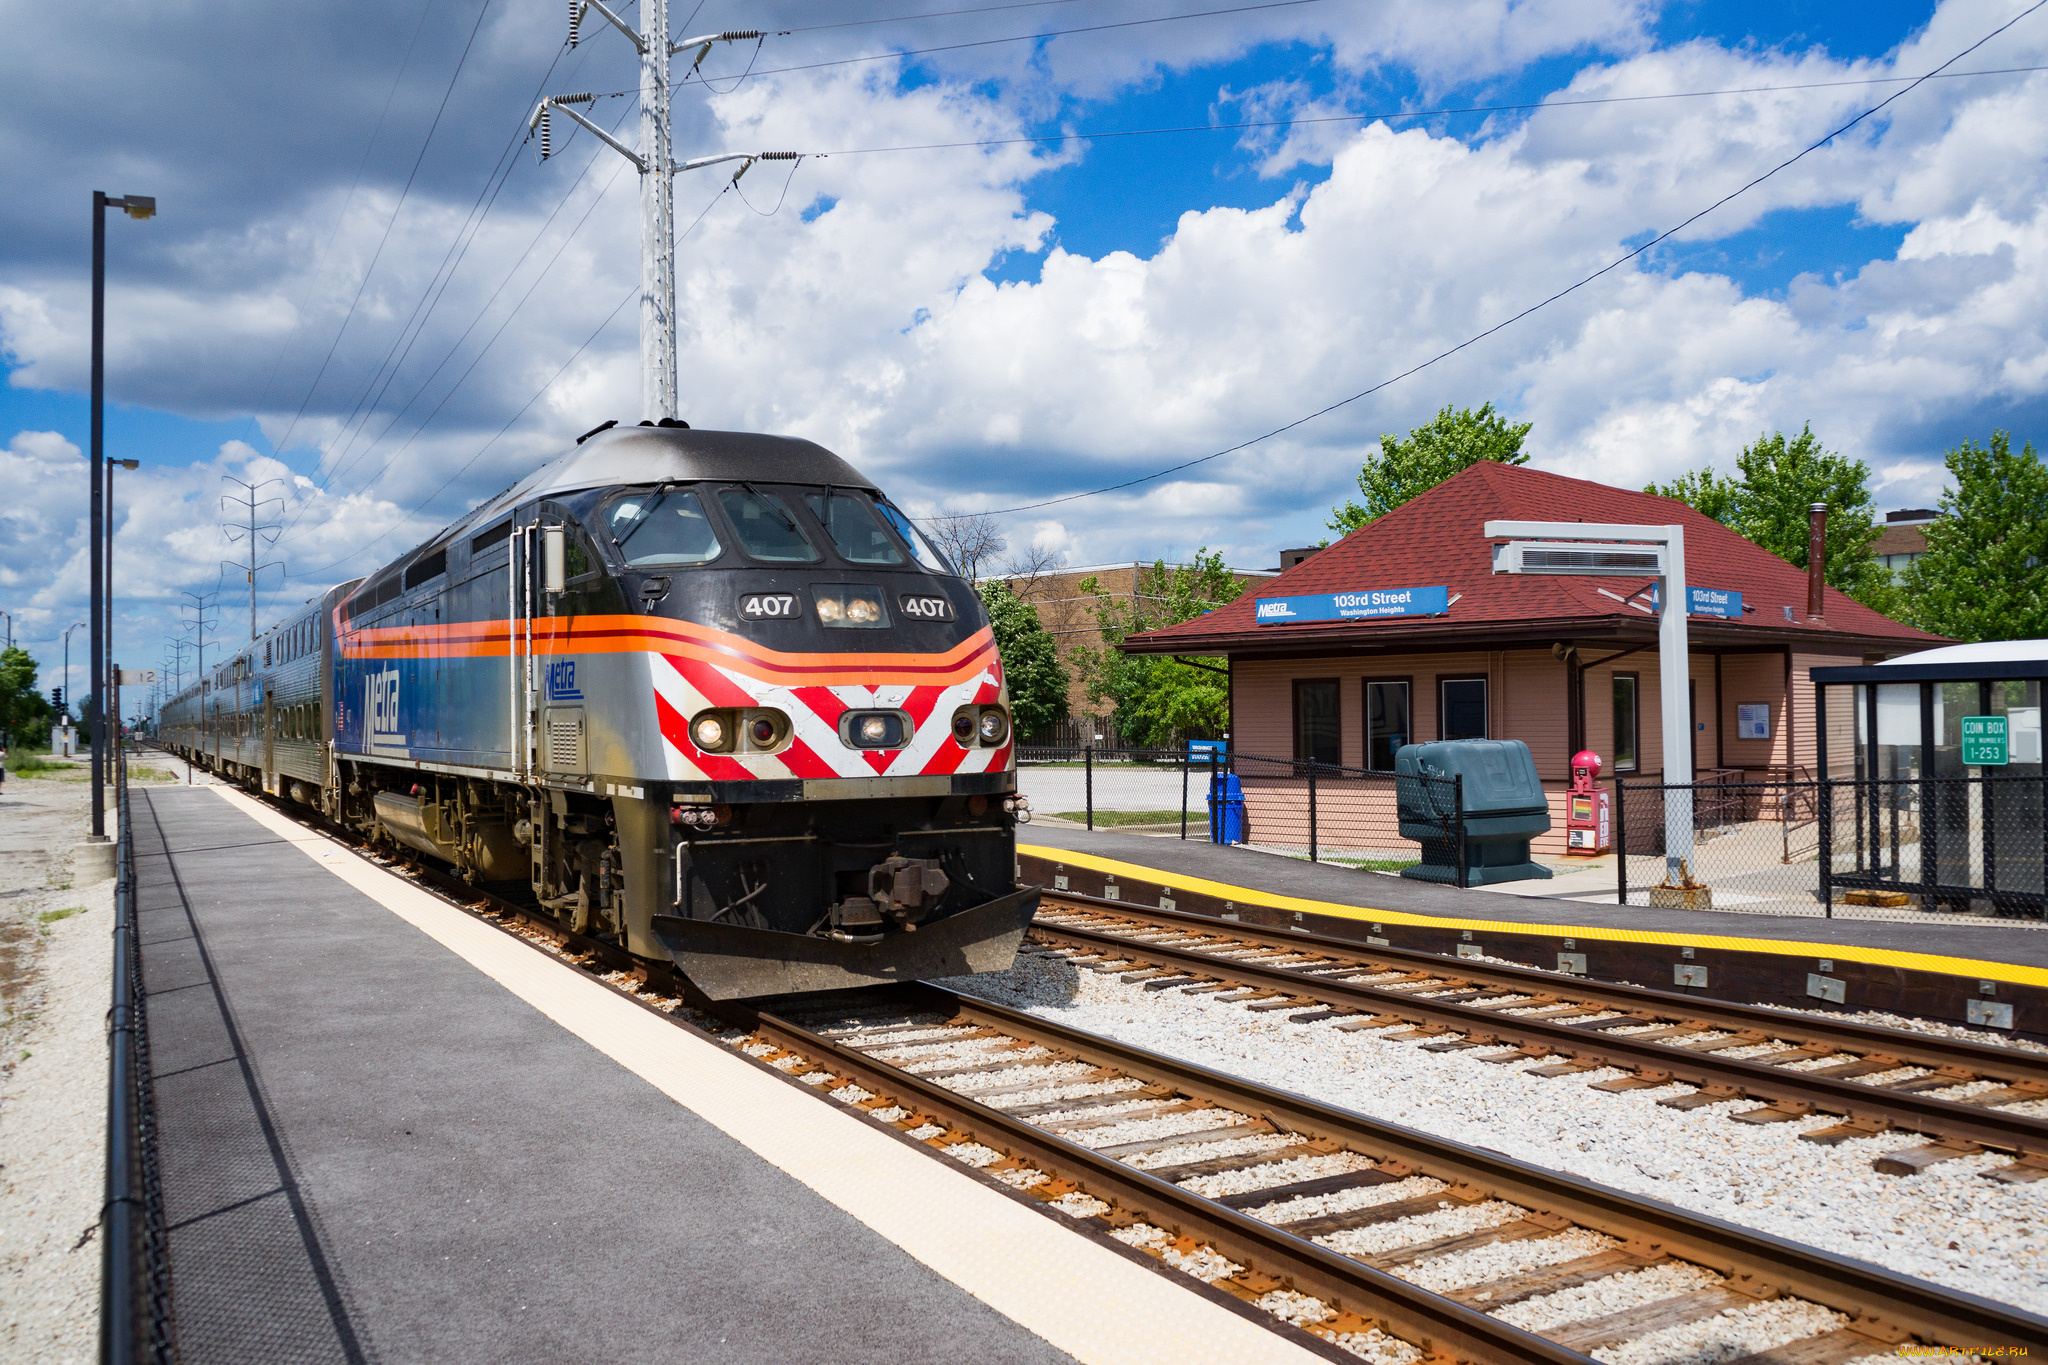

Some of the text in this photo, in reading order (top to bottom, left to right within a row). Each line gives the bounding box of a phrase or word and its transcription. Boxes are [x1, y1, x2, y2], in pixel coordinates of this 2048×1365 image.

[1333, 591, 1412, 608] 103rd Street
[1692, 590, 1728, 605] 103rd Street
[745, 595, 946, 617] 407 407
[1258, 602, 1289, 617] Metra
[1340, 606, 1405, 617] Washington Heights
[544, 657, 576, 701] Metra
[362, 660, 400, 754] Metra
[1965, 722, 2004, 734] COIN BOX
